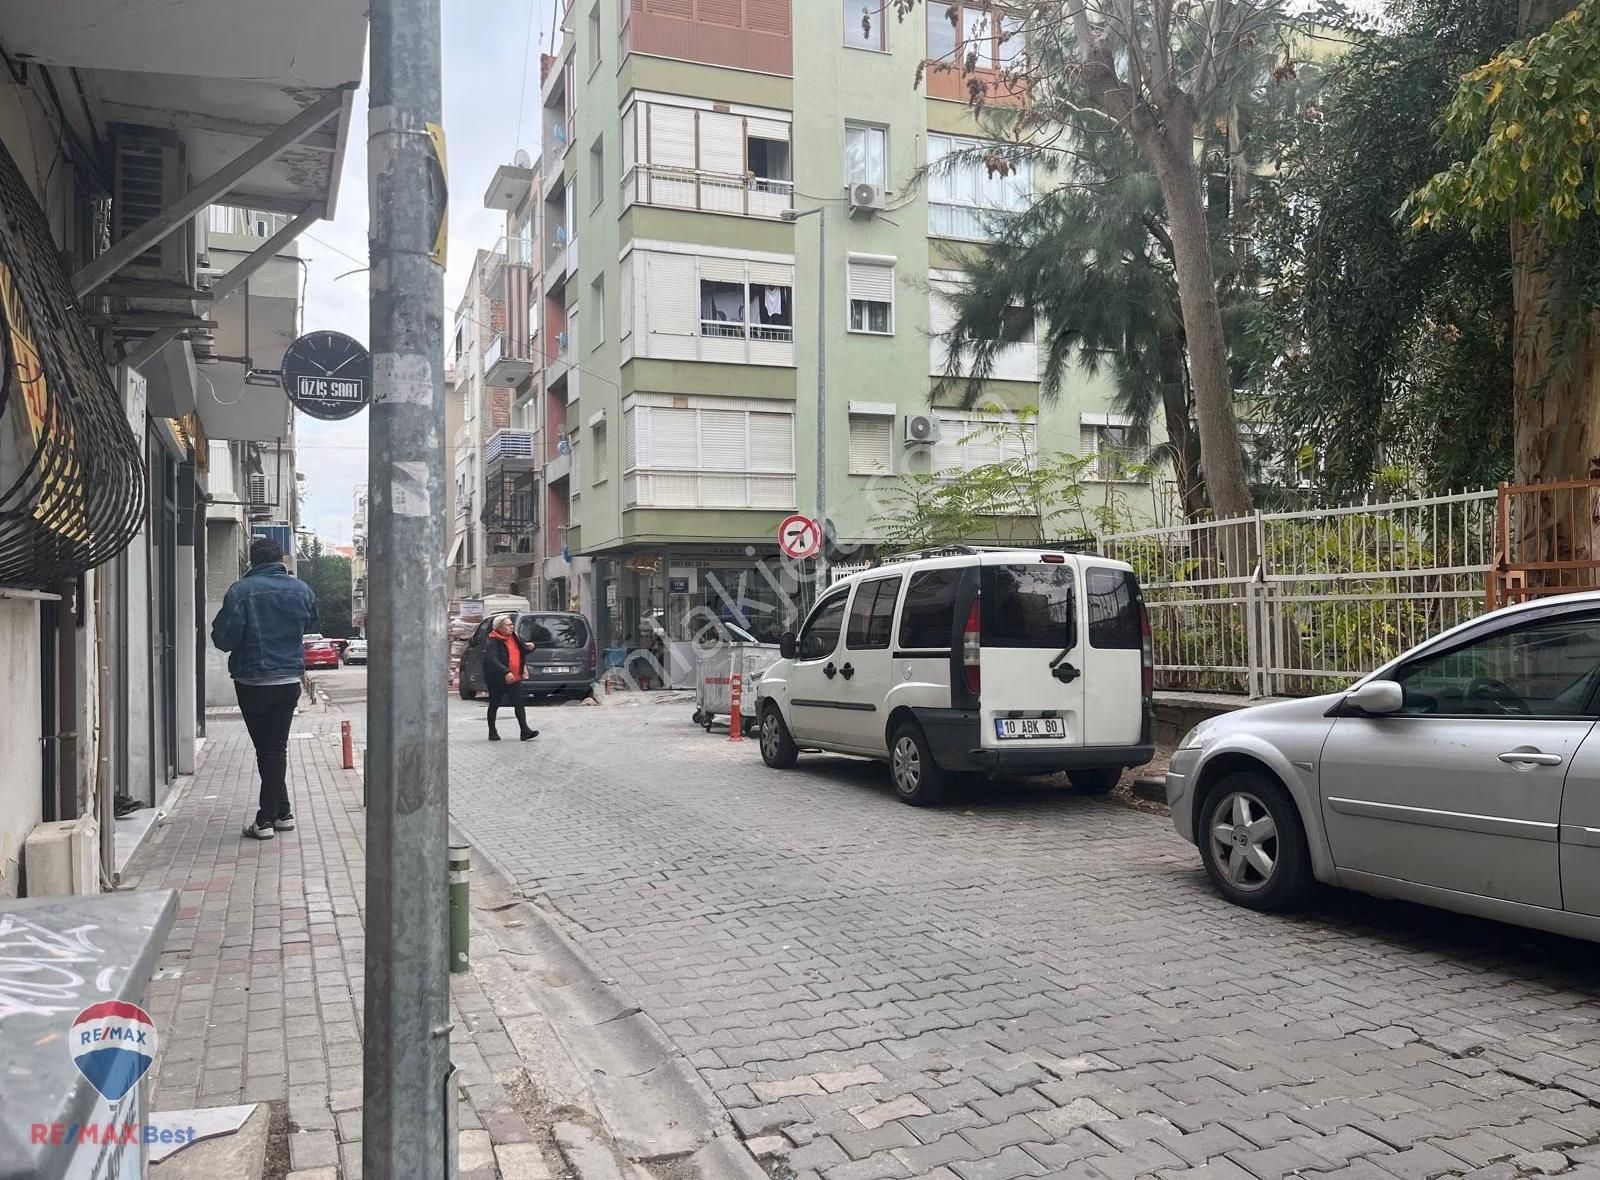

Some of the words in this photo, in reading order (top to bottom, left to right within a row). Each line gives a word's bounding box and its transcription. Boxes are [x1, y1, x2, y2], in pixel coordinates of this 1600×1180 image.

[300, 378, 327, 398] ÖZİŞ
[331, 381, 359, 398] SAAT
[1005, 721, 1016, 734] 10
[1022, 720, 1040, 733] ABK
[1045, 720, 1057, 733] 80
